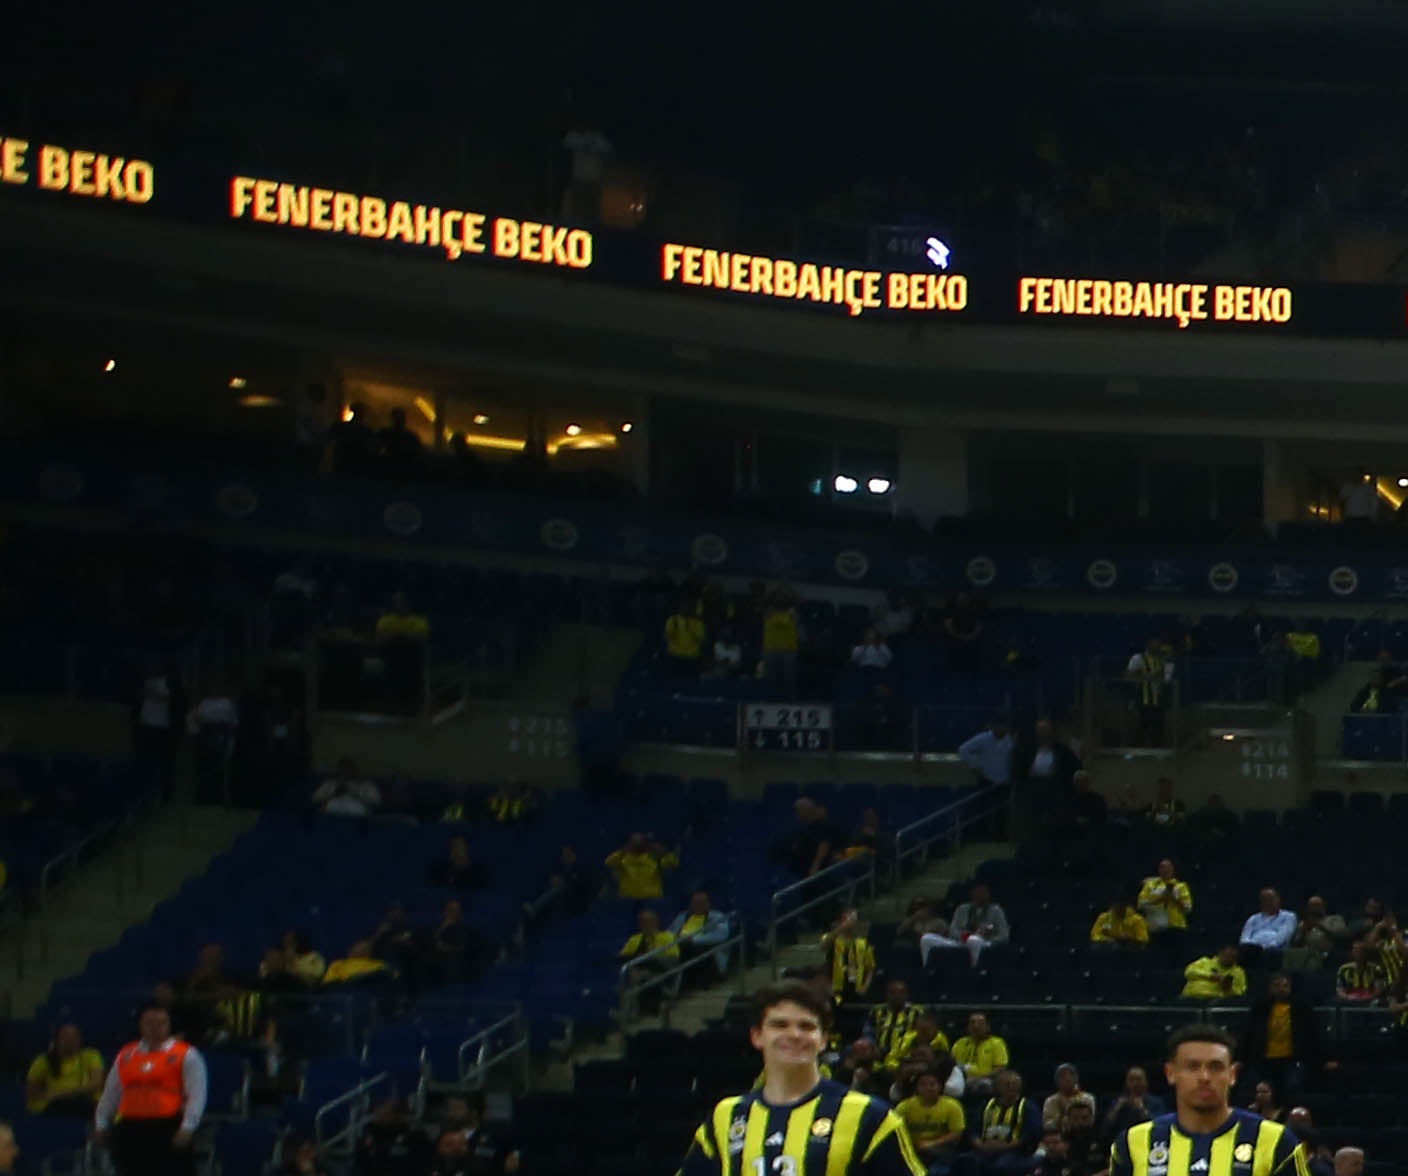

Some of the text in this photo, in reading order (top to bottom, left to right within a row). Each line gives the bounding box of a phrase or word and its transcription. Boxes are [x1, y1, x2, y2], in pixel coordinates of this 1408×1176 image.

[0, 139, 153, 204] E BEKO
[234, 178, 592, 268] FENERBAHÇE BEKO
[664, 244, 968, 316] FENERBAHÇE BEKO
[1020, 277, 1292, 328] FENERBAHÇE BEKO
